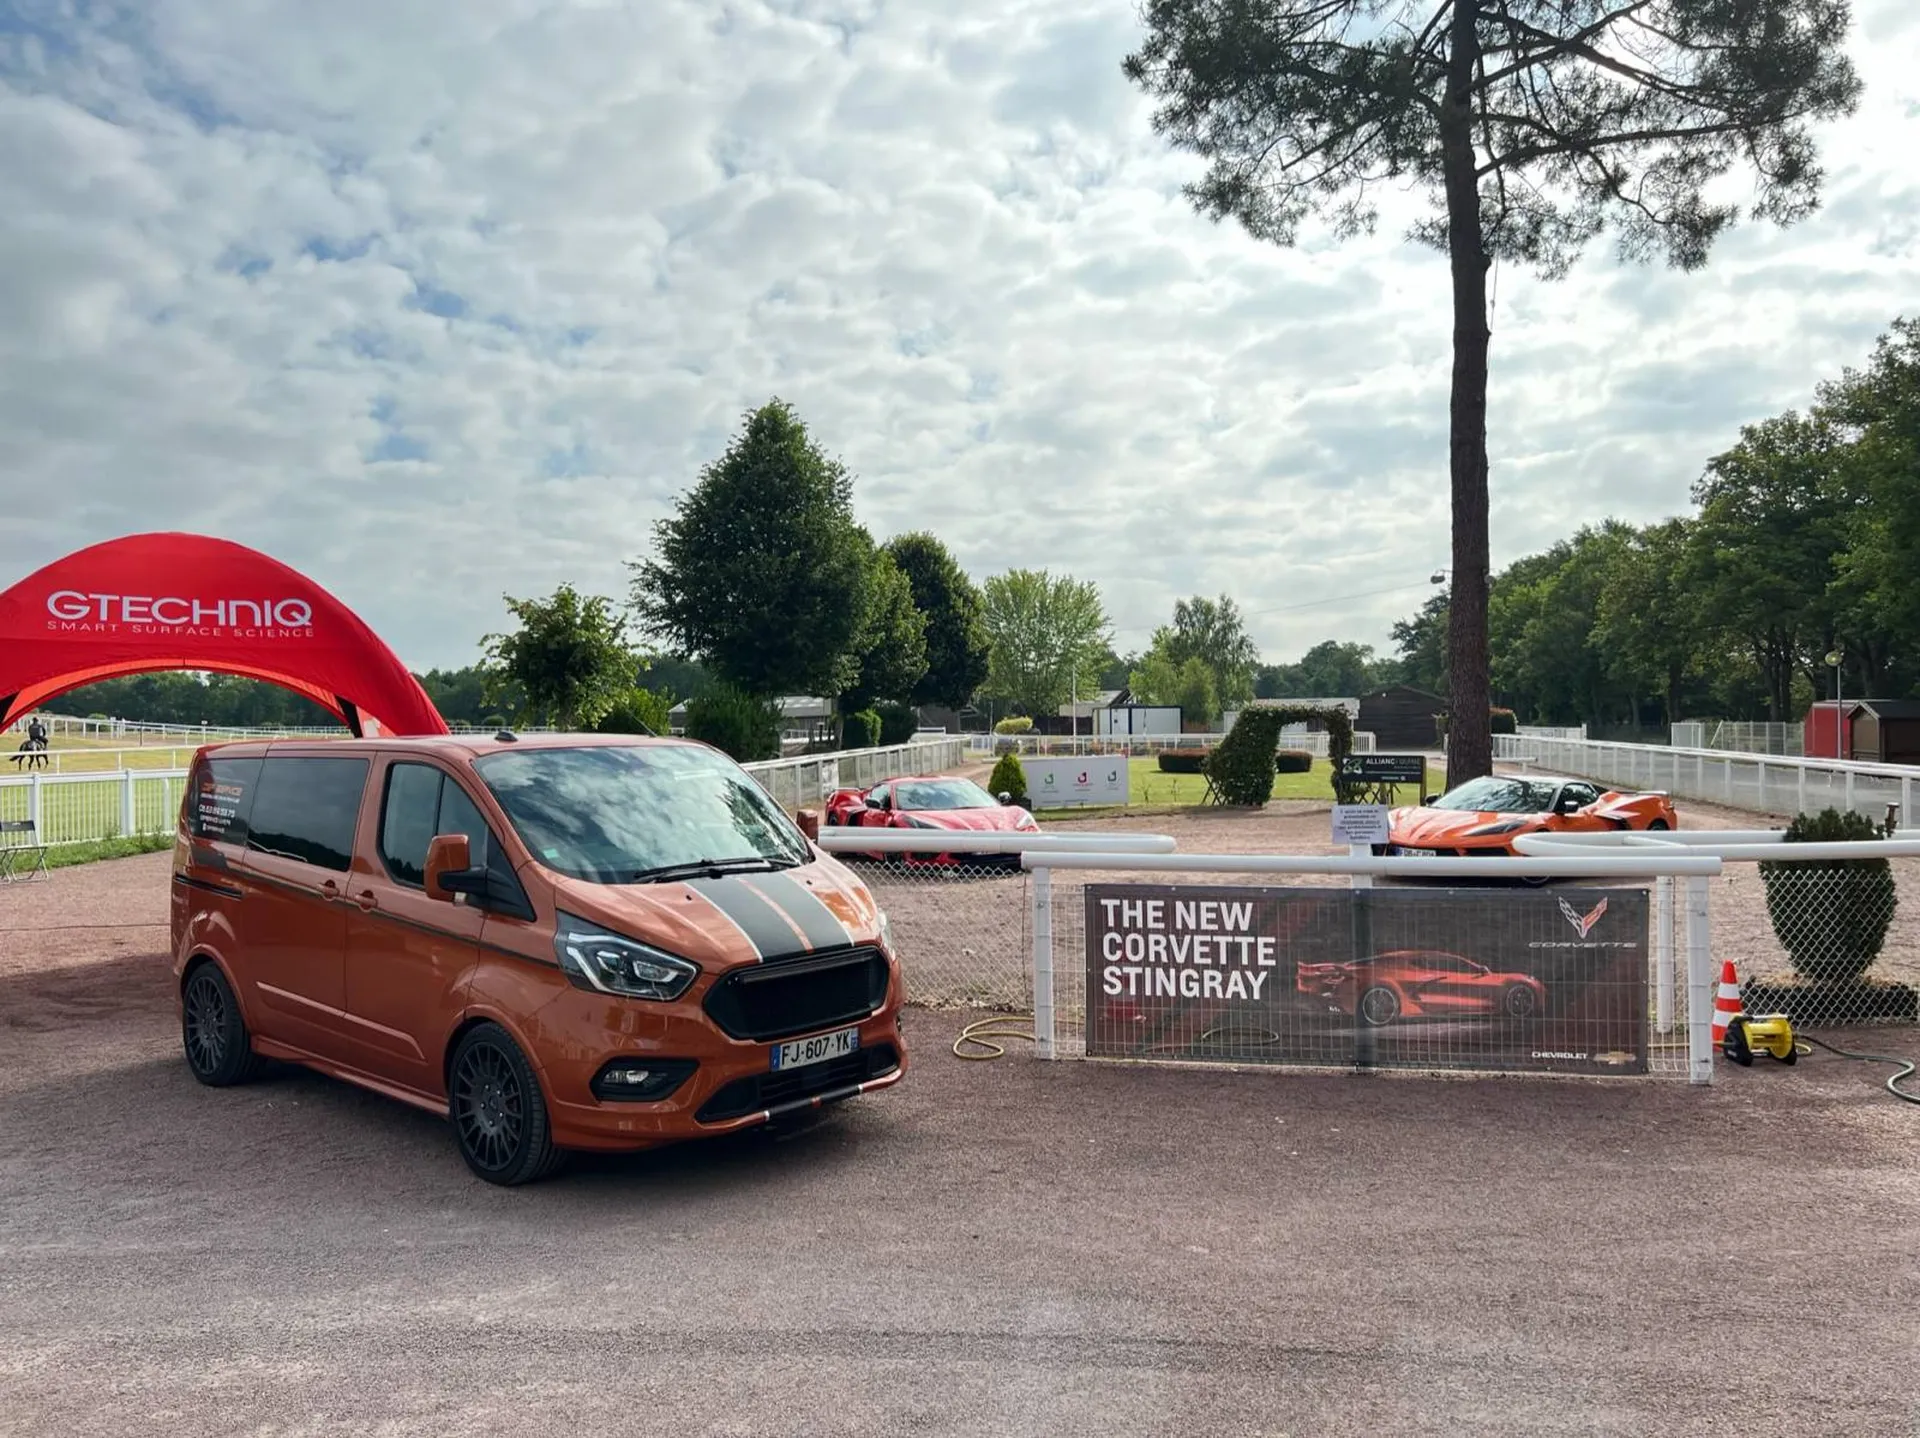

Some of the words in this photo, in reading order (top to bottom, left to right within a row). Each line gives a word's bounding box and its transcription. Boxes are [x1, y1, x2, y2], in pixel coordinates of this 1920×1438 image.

[47, 590, 313, 628] GTECHNIQ
[47, 620, 119, 633] SMART
[132, 624, 221, 637] SURFACE
[233, 627, 314, 639] SCIENCE
[1100, 898, 1165, 929] THE
[1175, 900, 1253, 931] NEW
[1102, 932, 1277, 966] CORVETTE
[1528, 941, 1638, 949] CORVETTE
[1102, 965, 1268, 1000] STINGRAY
[1531, 1051, 1589, 1060] CHEVROLET
